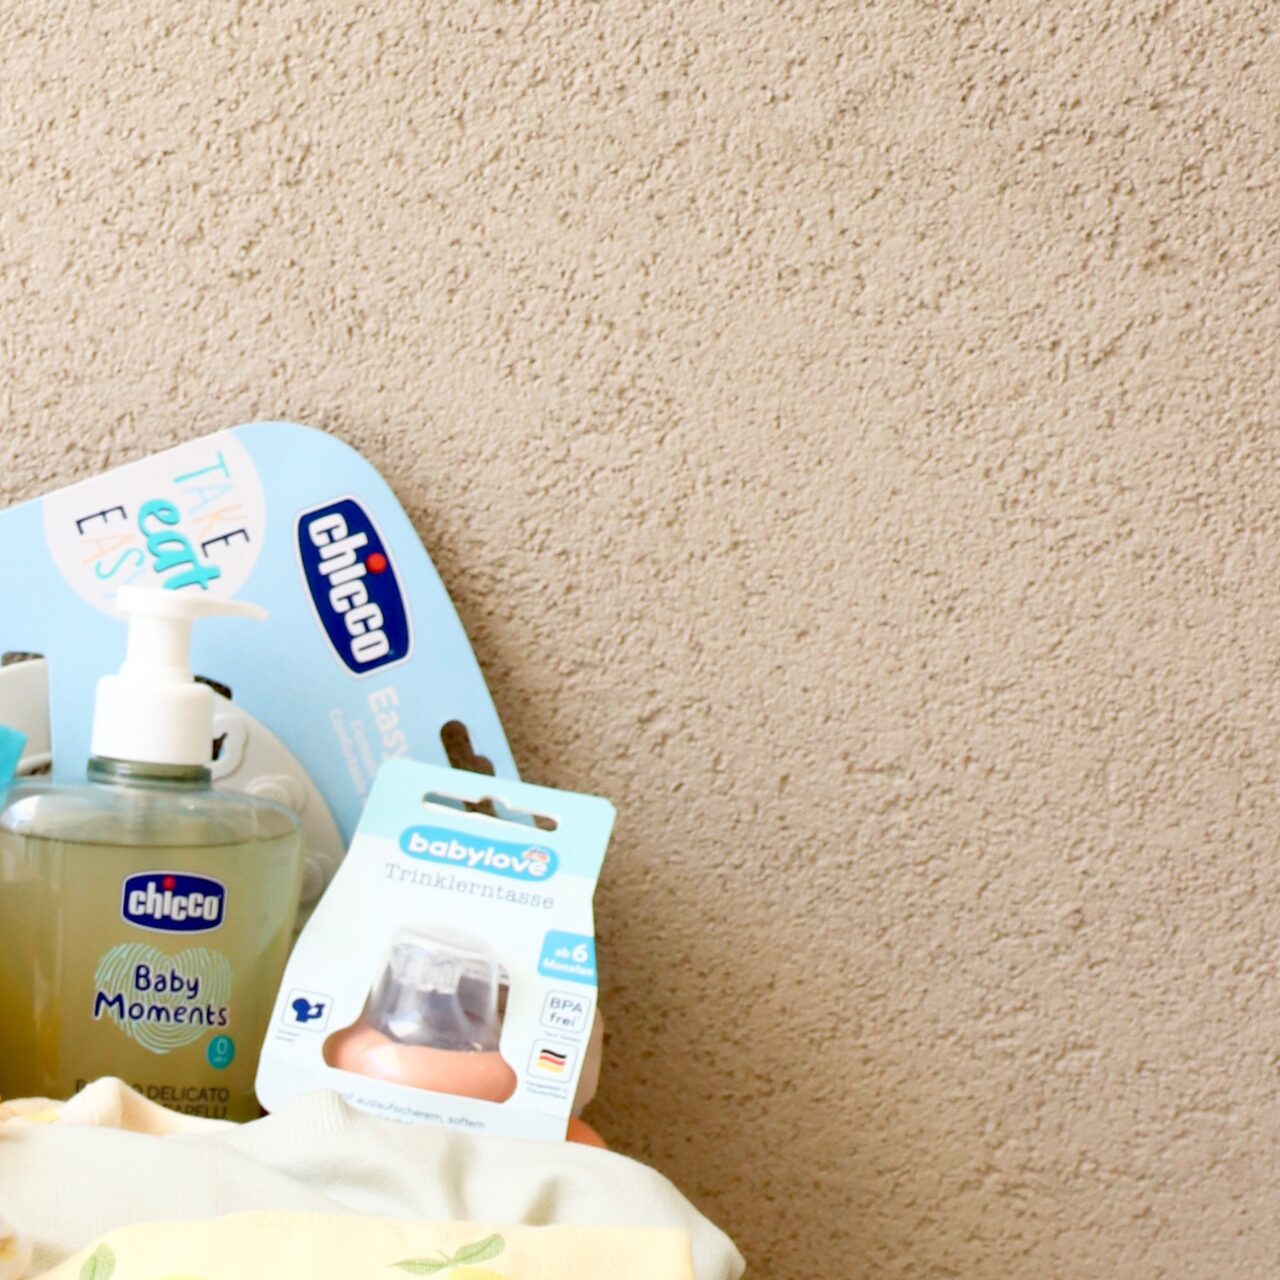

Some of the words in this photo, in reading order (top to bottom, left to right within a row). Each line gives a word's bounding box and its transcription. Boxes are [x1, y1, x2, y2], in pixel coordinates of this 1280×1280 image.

[174, 451, 250, 558] TAKE
[137, 499, 221, 590] eat
[308, 512, 390, 664] chicco
[408, 831, 548, 877] babylove
[128, 875, 221, 921] chicco
[385, 862, 555, 910] Trinklerntasse
[571, 943, 589, 963] 6
[135, 964, 200, 999] Baby
[94, 991, 228, 1026] Moments
[549, 1012, 576, 1027] frei
[550, 997, 583, 1014] BPA
[147, 1084, 230, 1103] DELICATO
